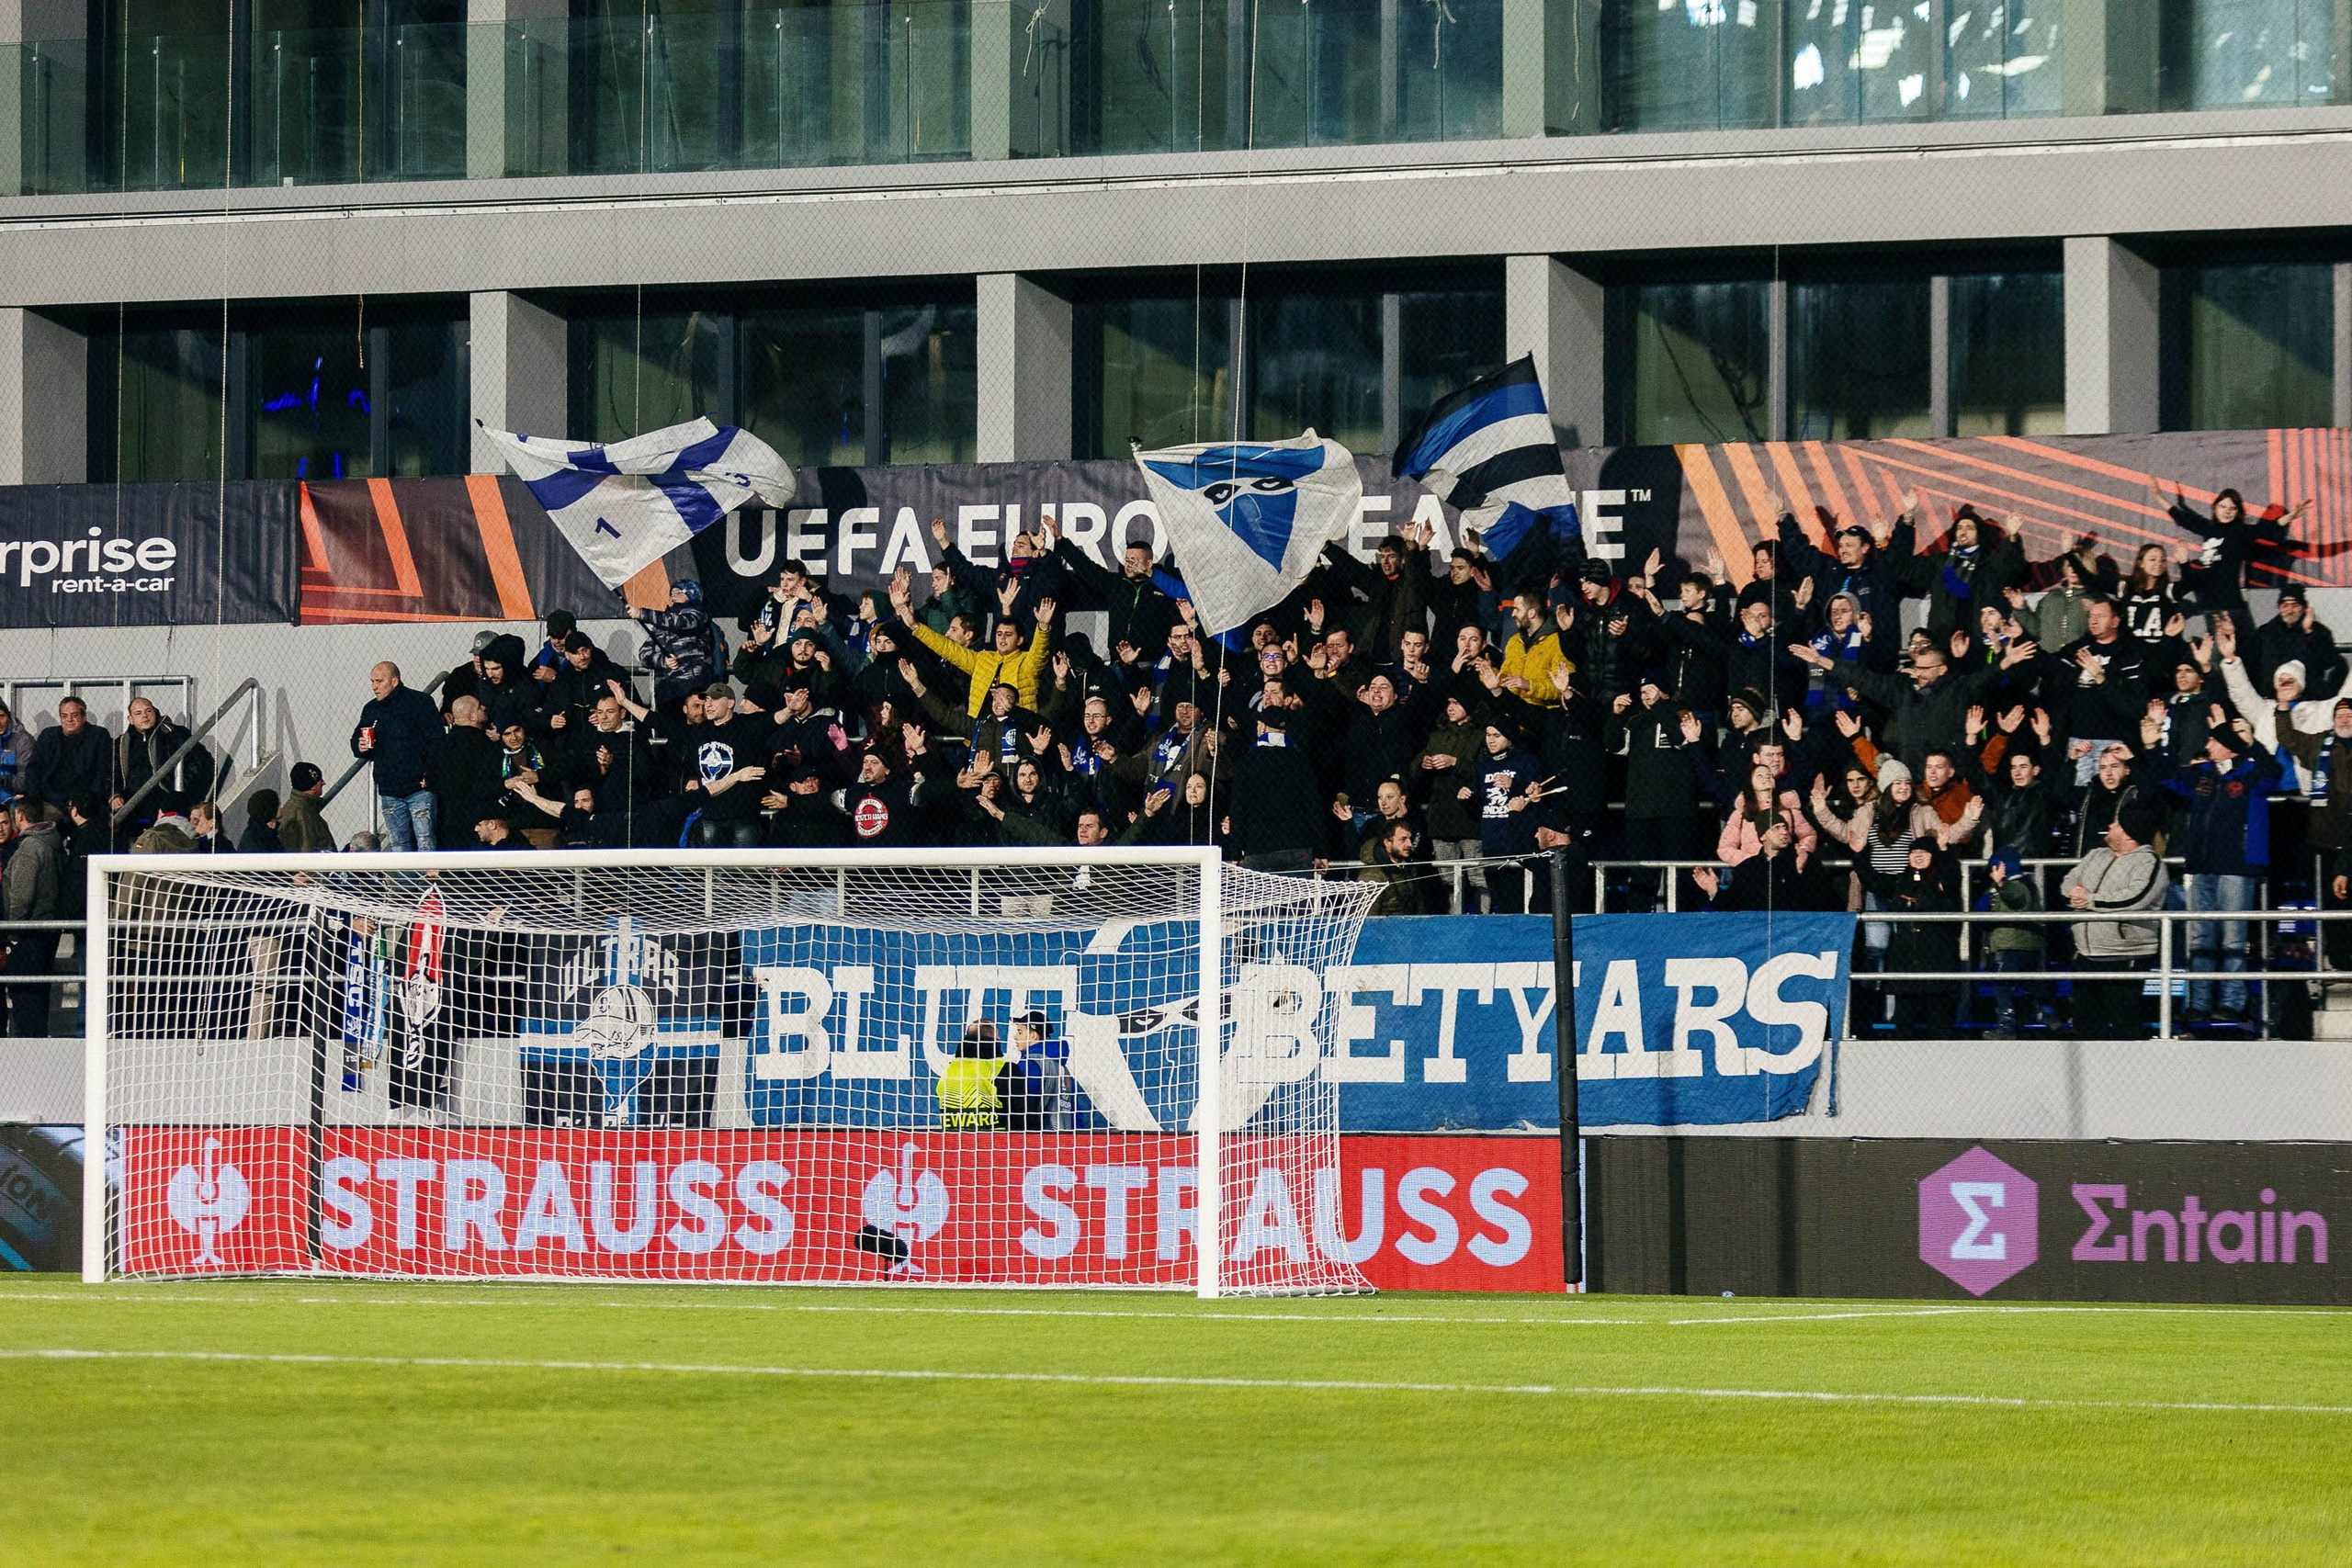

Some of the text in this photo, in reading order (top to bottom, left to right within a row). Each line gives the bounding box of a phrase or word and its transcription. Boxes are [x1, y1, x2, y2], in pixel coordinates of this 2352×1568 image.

[726, 507, 933, 577] UEFA
[958, 499, 1170, 571] EURO
[52, 574, 175, 593] rent-a-car
[348, 941, 365, 1008] TSC
[564, 936, 680, 1002] ULTRAS
[1237, 951, 1838, 1083] BETYARS
[322, 1157, 795, 1256] STRAUSS
